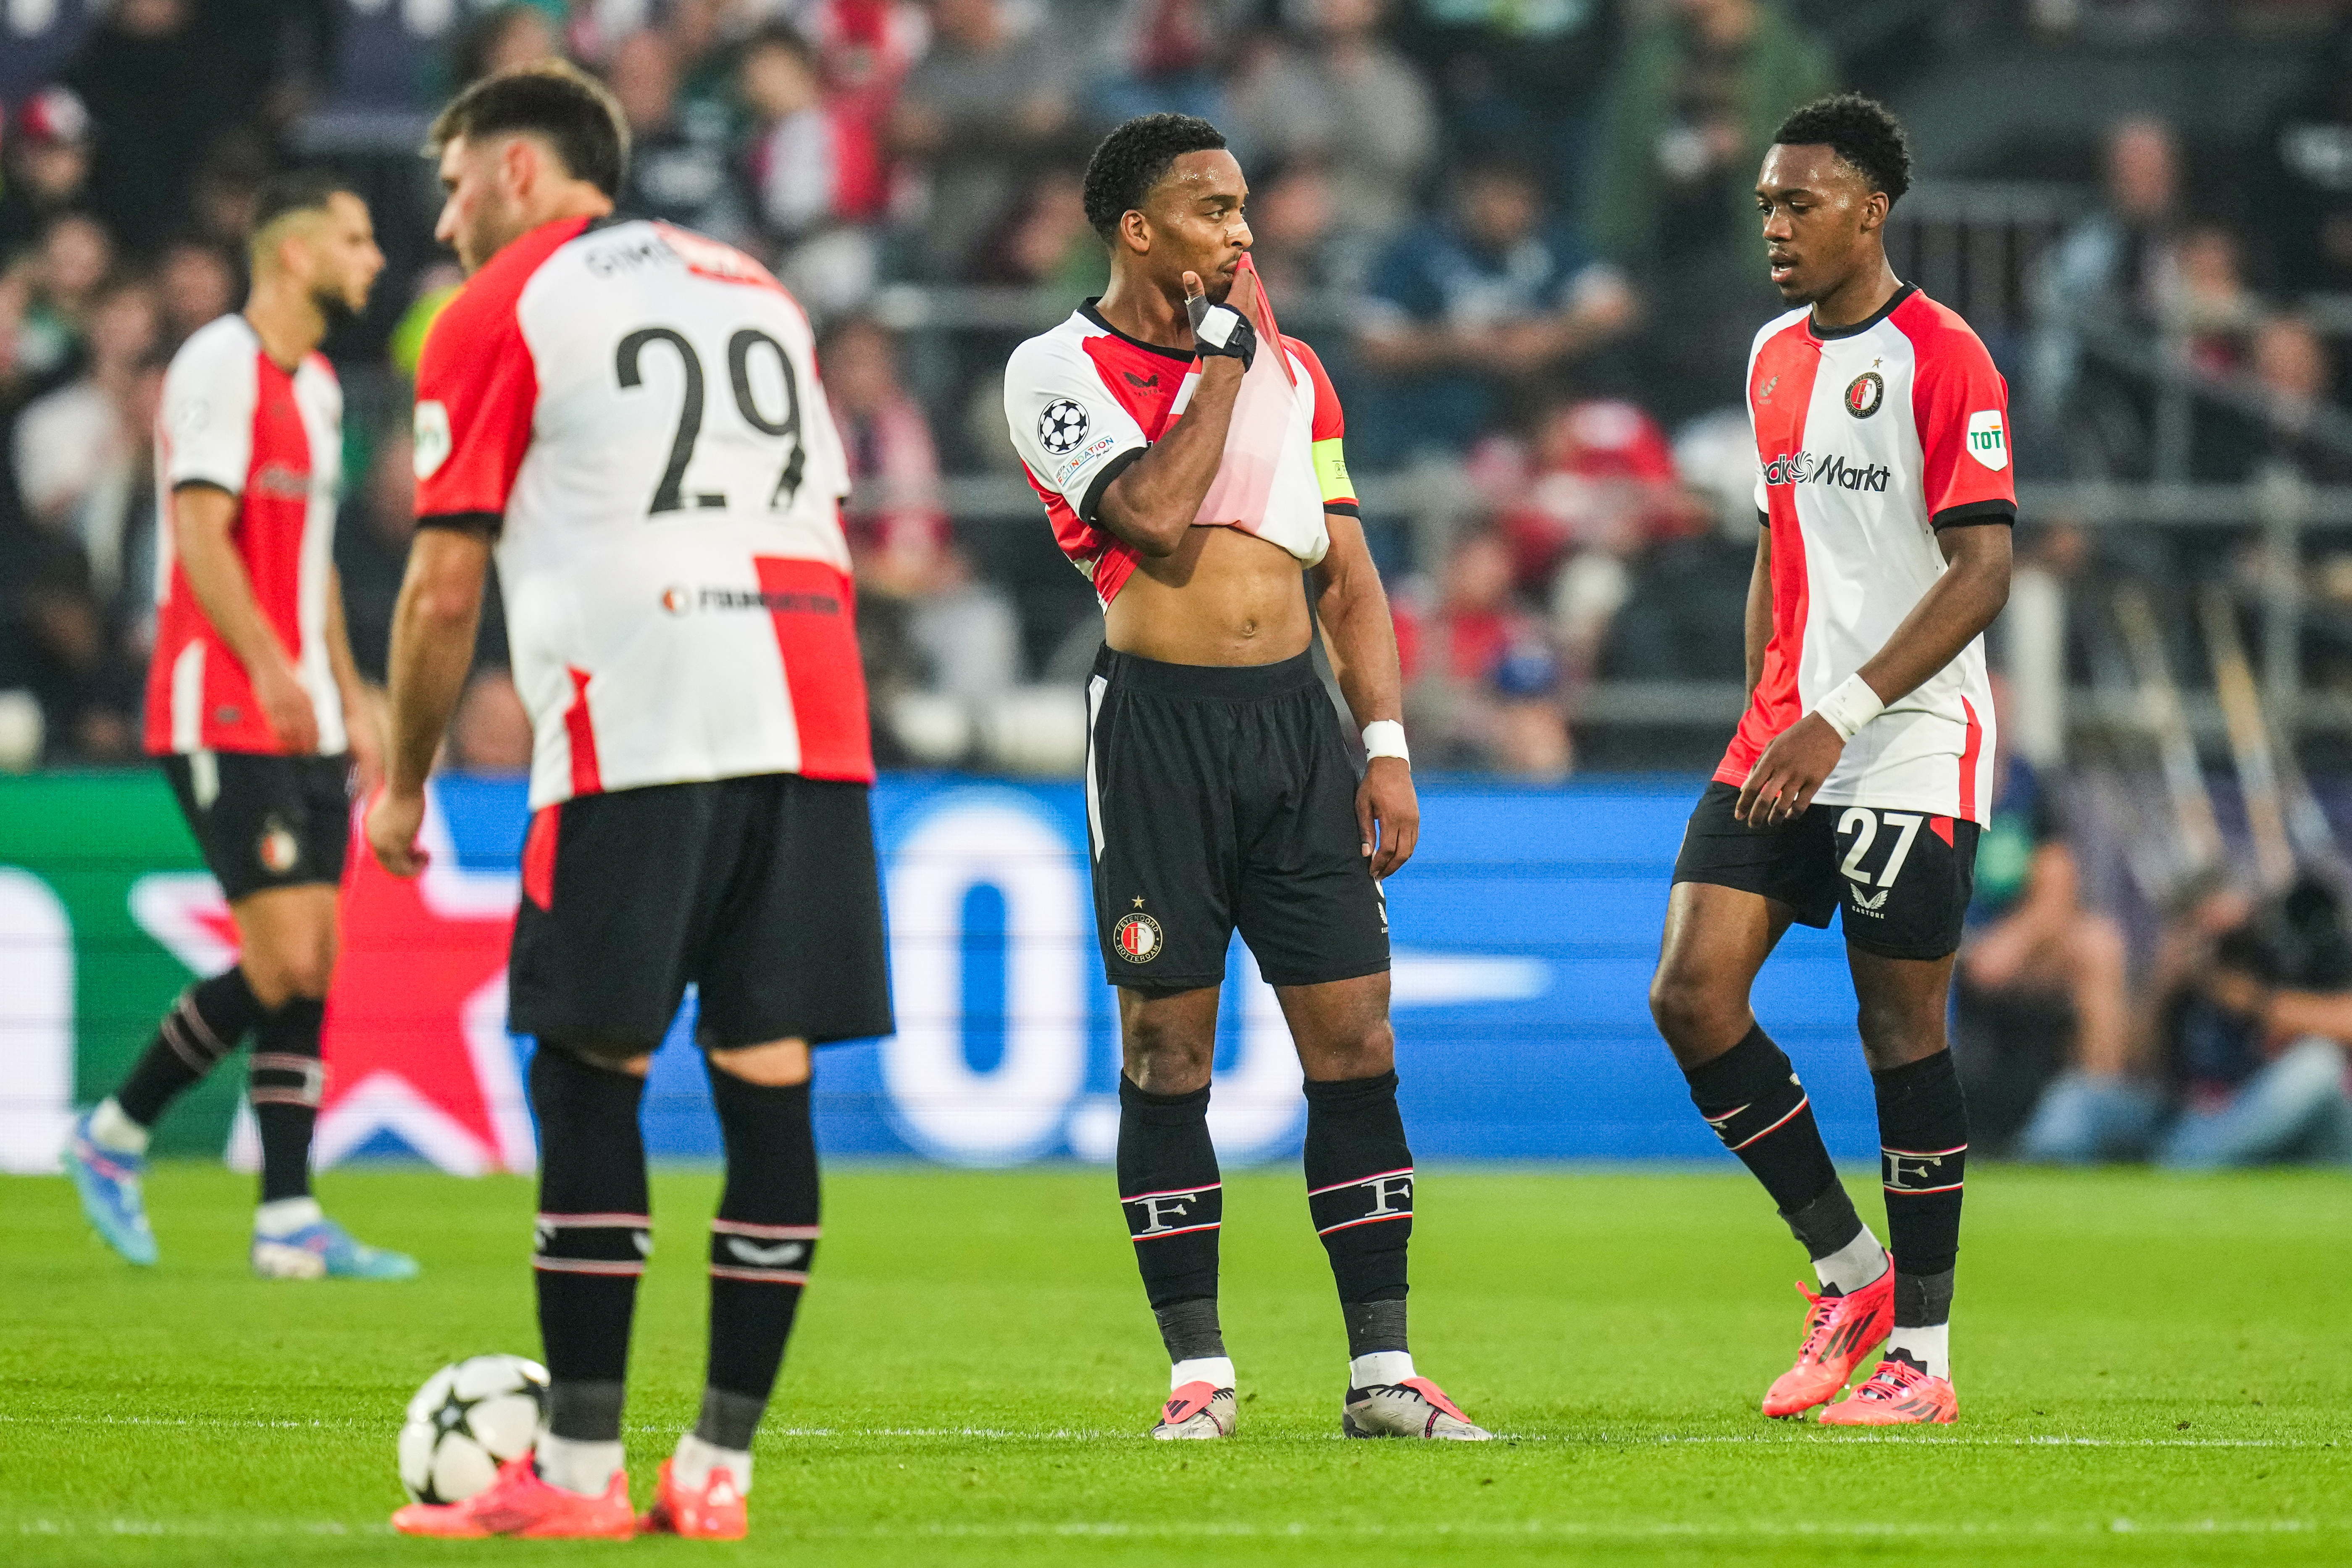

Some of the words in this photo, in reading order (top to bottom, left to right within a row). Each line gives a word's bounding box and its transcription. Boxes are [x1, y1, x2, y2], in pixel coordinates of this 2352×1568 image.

[616, 328, 805, 518] 29
[1055, 465, 1066, 478] UEFA
[1058, 437, 1114, 485] FOUNDATION
[1813, 454, 1890, 492] Markt
[1837, 806, 1924, 888] 27
[1117, 915, 1159, 932] FEYENOORD
[1852, 905, 1884, 919] CASTORE
[1117, 944, 1159, 962] ROTTERDAM
[1128, 927, 1146, 949] F
[1883, 1153, 1942, 1188] F
[1361, 1174, 1414, 1216] F
[1135, 1193, 1197, 1234] F
